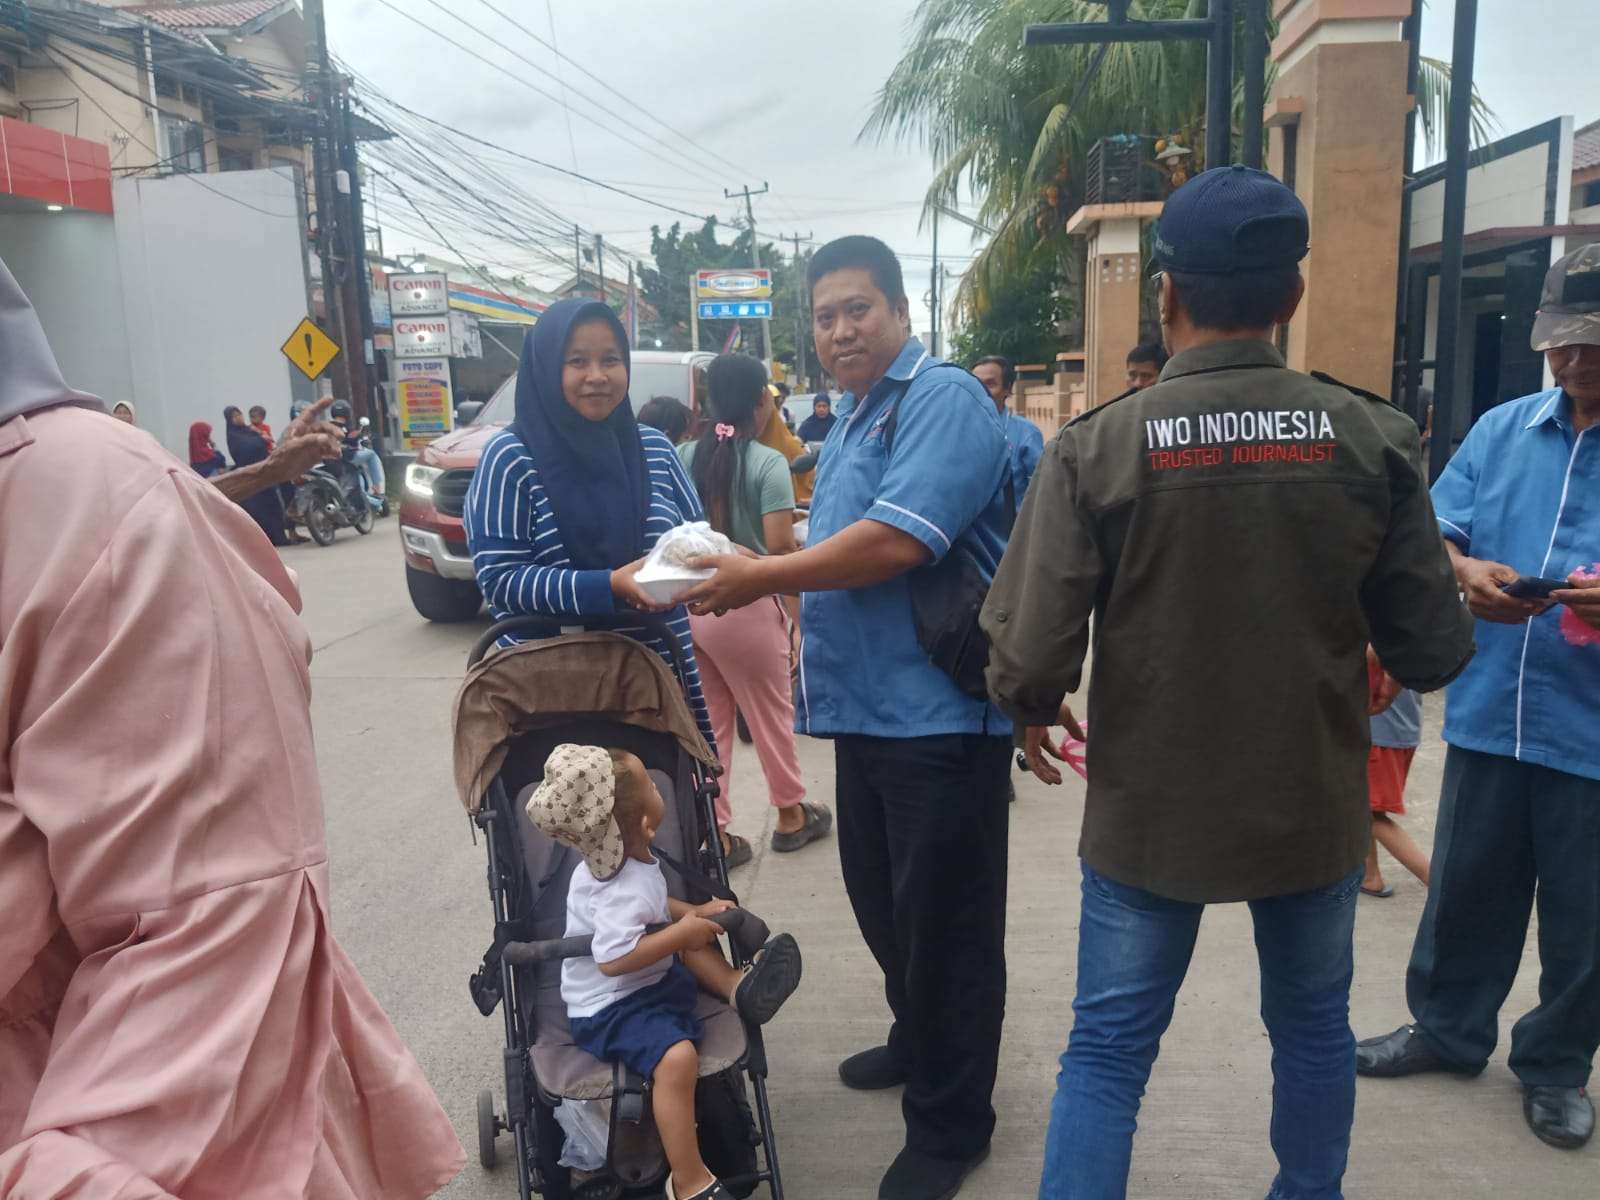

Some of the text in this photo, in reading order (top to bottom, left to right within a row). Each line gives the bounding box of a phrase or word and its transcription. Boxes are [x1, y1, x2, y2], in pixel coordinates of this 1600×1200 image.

[392, 280, 442, 291] Canon
[400, 304, 438, 312] ADVANCE
[396, 323, 446, 334] Canon
[402, 362, 443, 371] FOTO COPY
[1145, 410, 1336, 449] IWO INDONESIA
[1147, 443, 1337, 471] TRUSTED JOURNALIST
